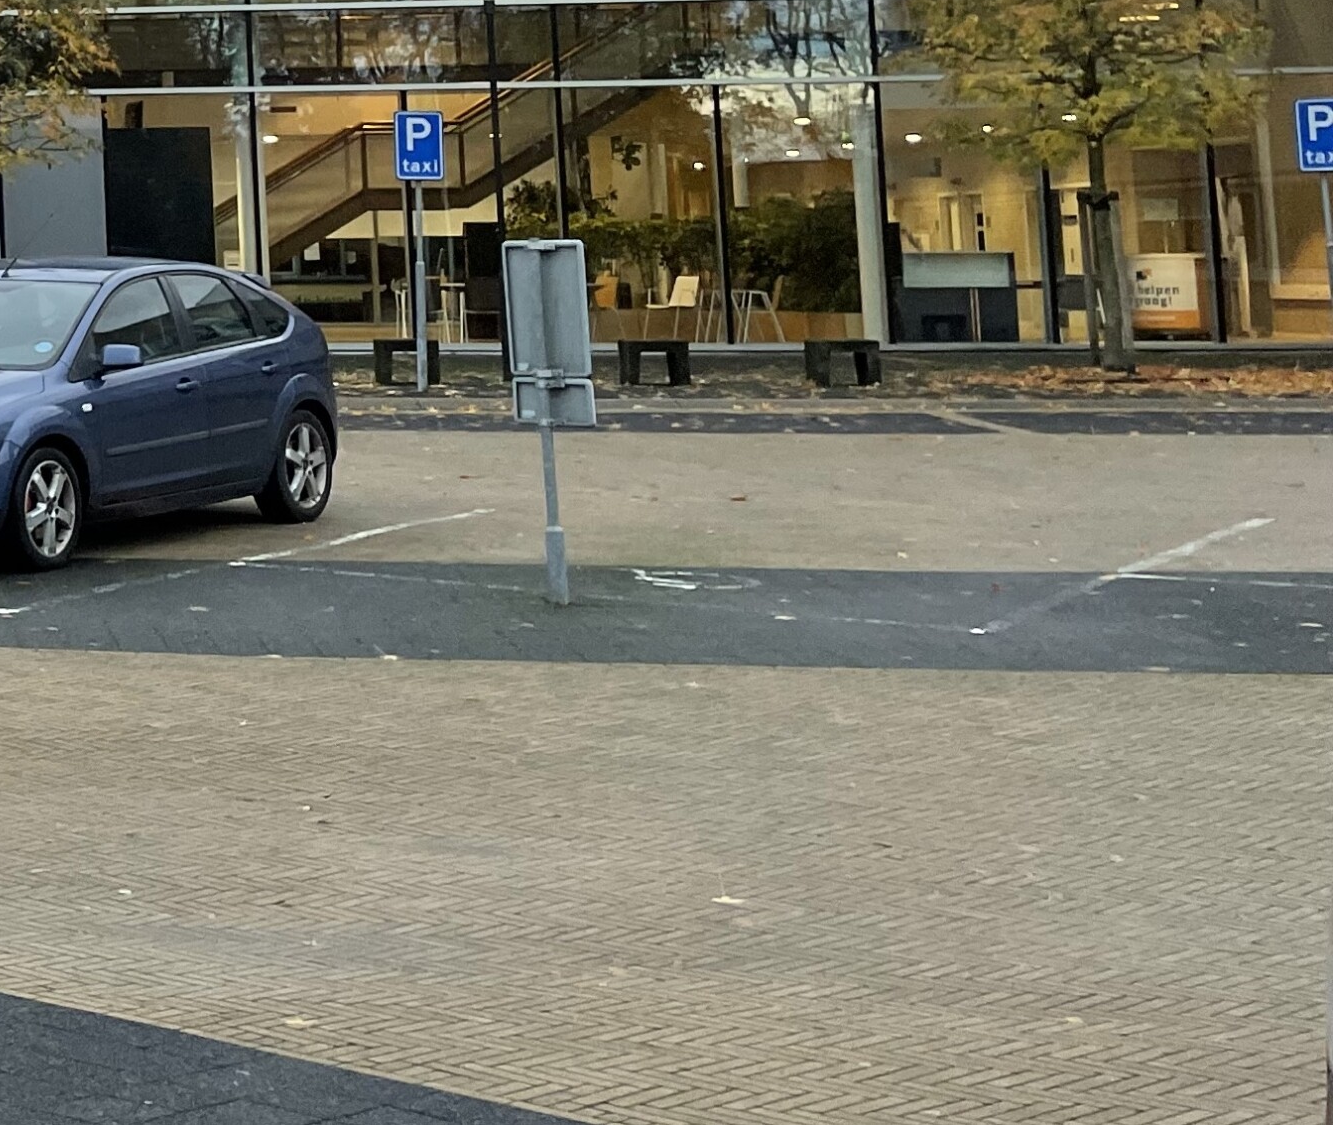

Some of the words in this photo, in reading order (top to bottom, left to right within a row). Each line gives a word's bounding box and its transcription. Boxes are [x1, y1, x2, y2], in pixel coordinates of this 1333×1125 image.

[406, 117, 431, 151] P
[1307, 105, 1333, 141] P
[402, 159, 438, 173] taxi
